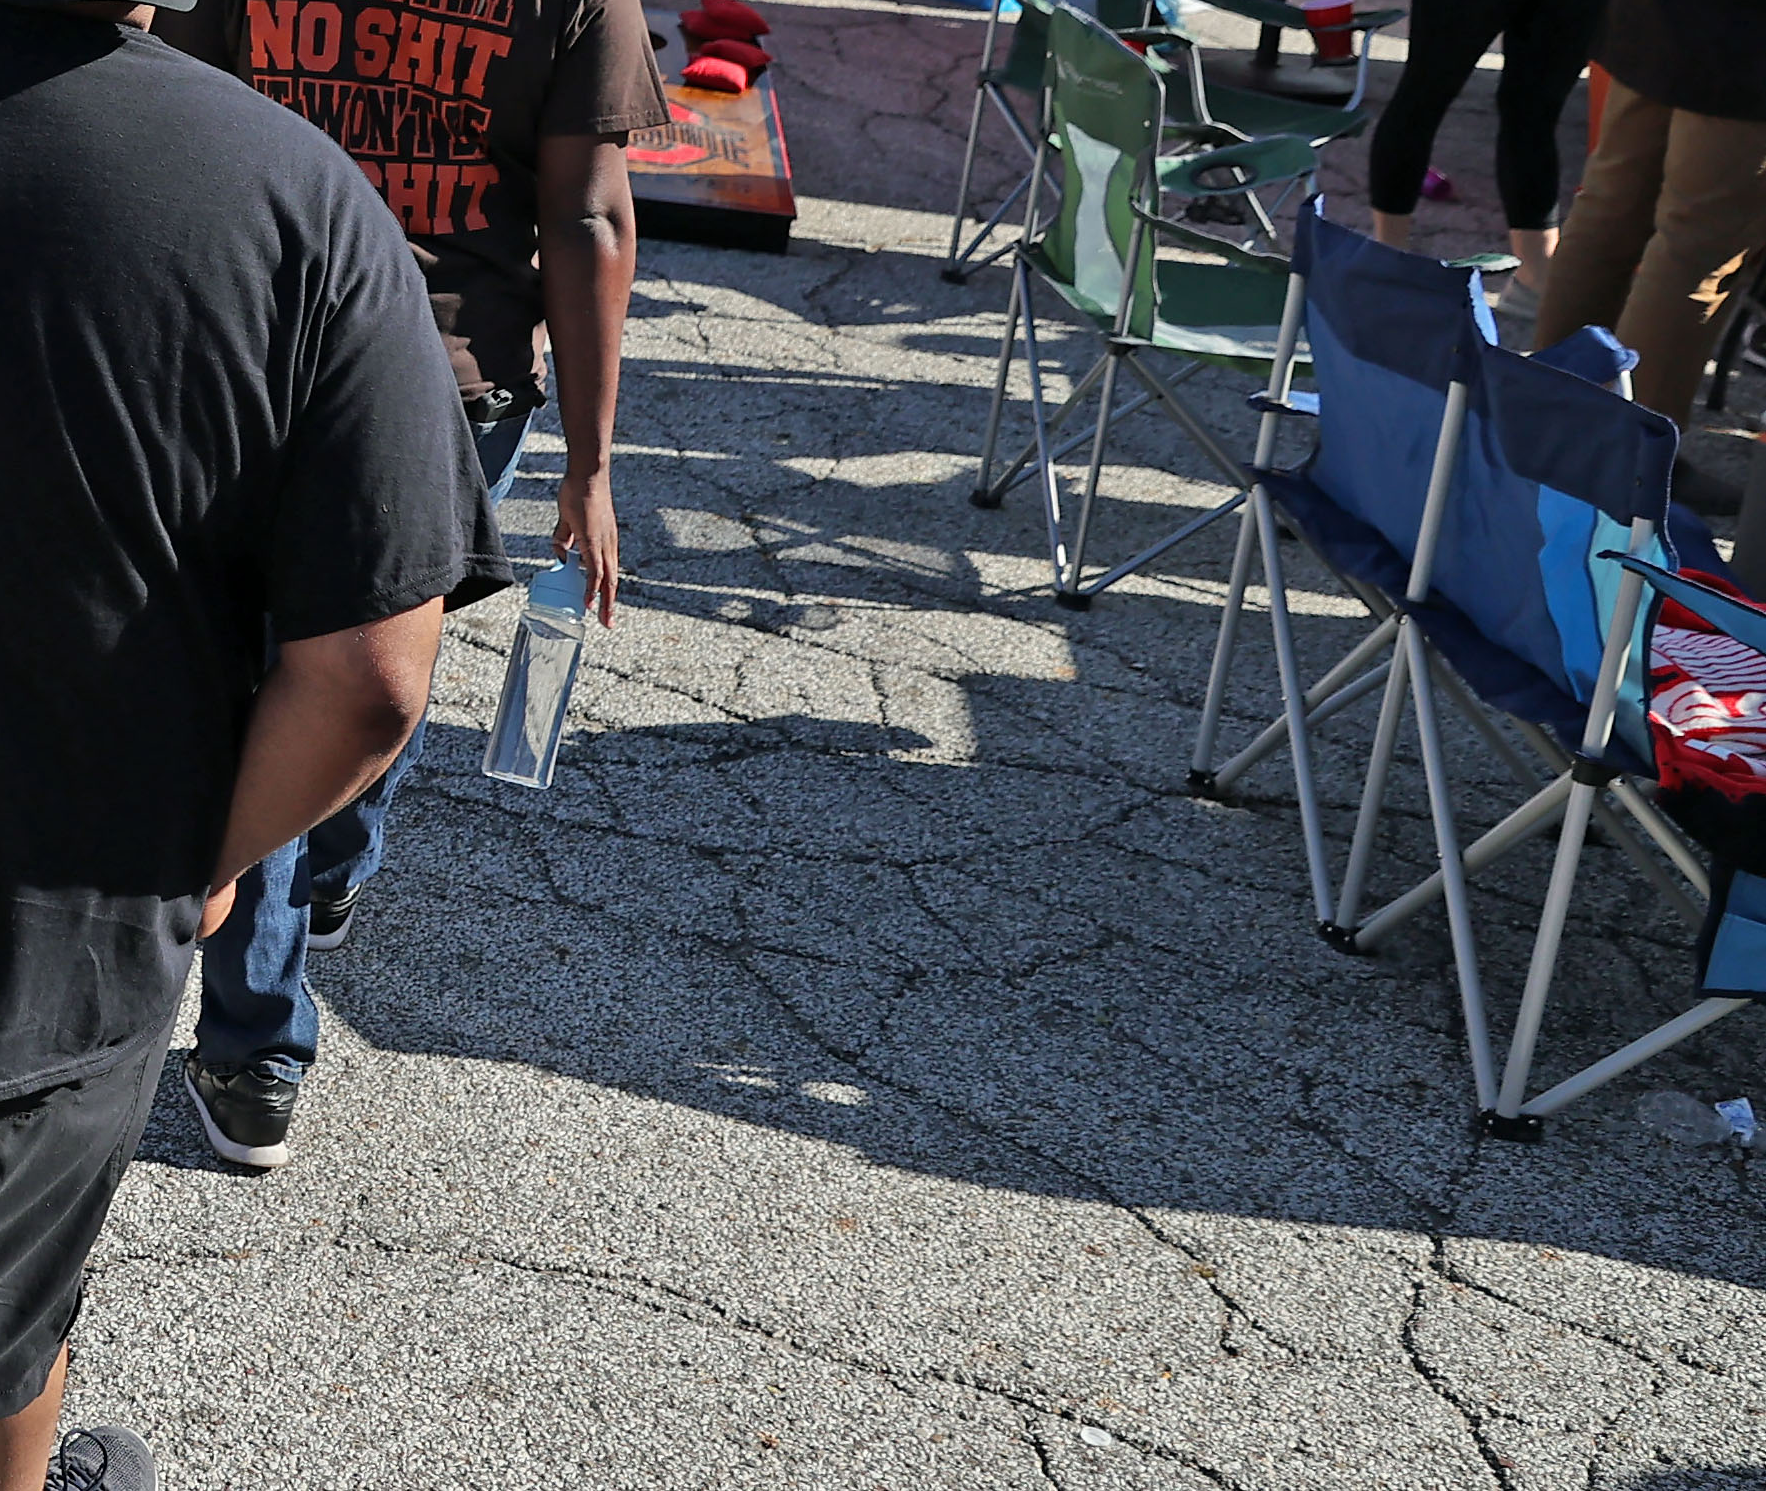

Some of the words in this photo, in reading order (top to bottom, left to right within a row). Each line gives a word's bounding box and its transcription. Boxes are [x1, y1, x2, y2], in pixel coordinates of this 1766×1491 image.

[247, 0, 343, 73] NO
[353, 7, 513, 99] SHIT
[298, 76, 437, 158] WON'T
